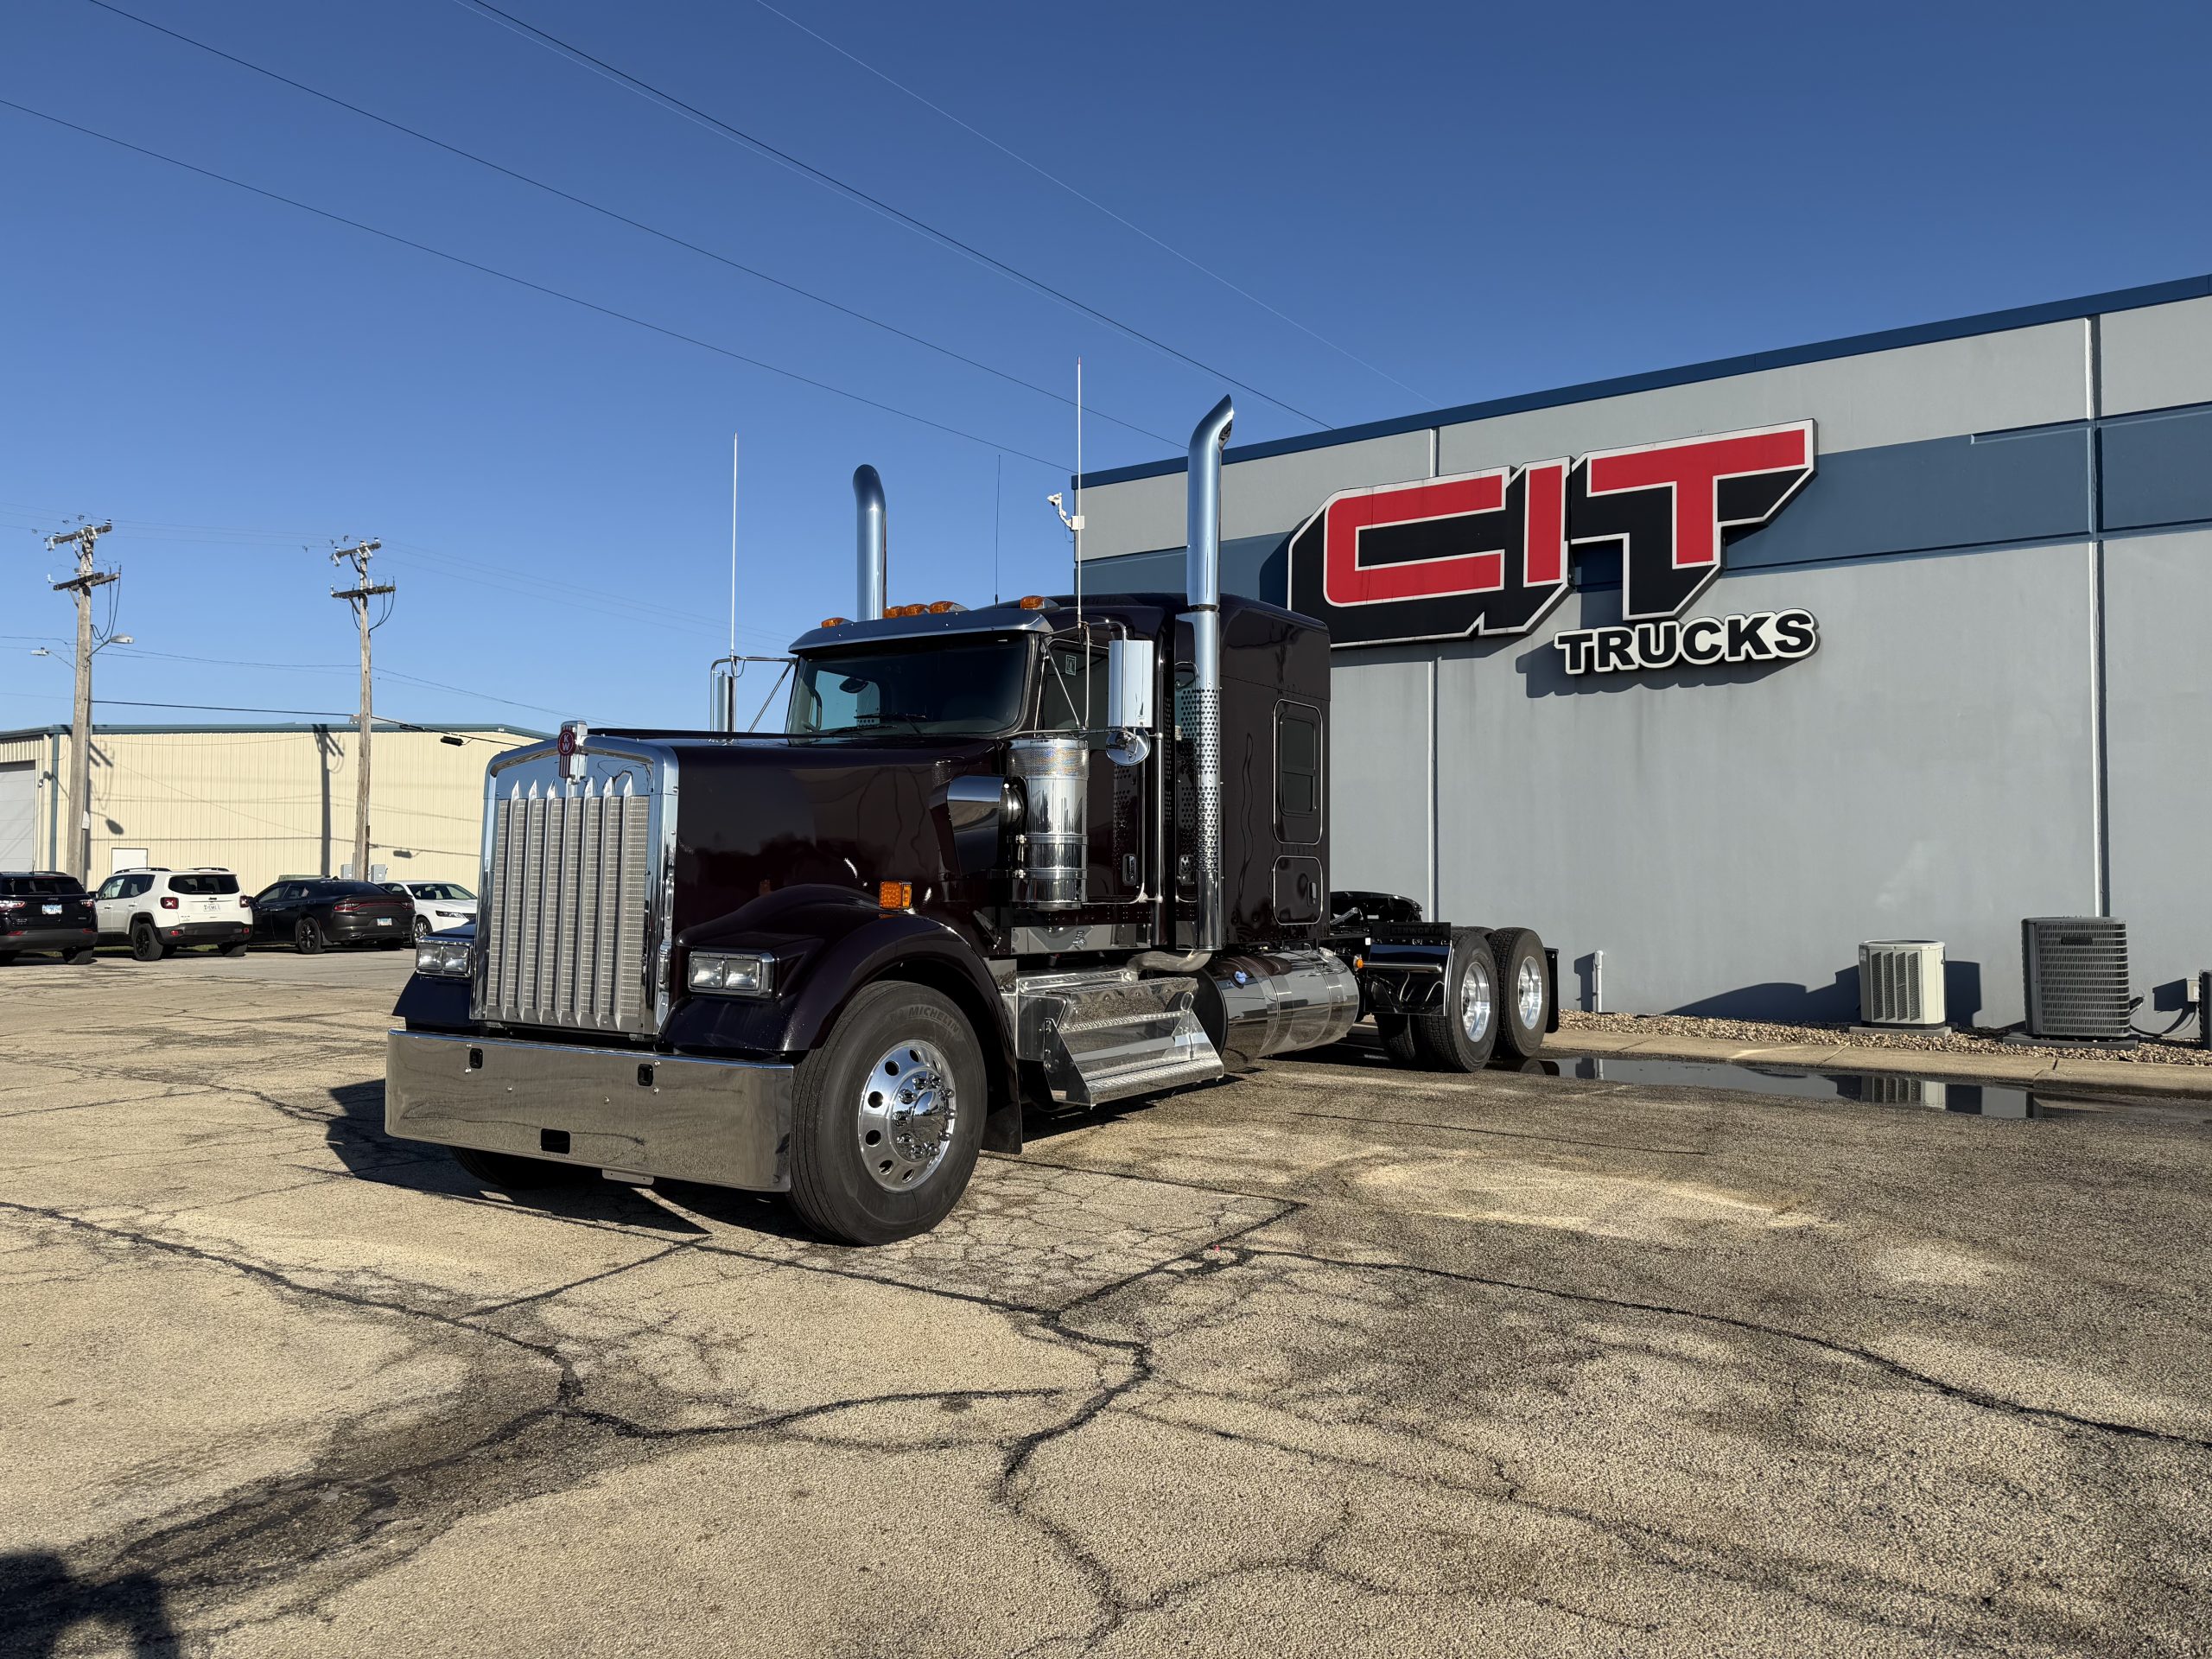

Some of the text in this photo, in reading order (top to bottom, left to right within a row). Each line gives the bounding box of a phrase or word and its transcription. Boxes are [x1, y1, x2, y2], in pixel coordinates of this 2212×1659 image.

[1325, 428, 1806, 606] CIT
[1558, 613, 1814, 671] TRUCKS
[1392, 925, 1444, 936] KENWORTH
[908, 1006, 960, 1033] MICHELIN
